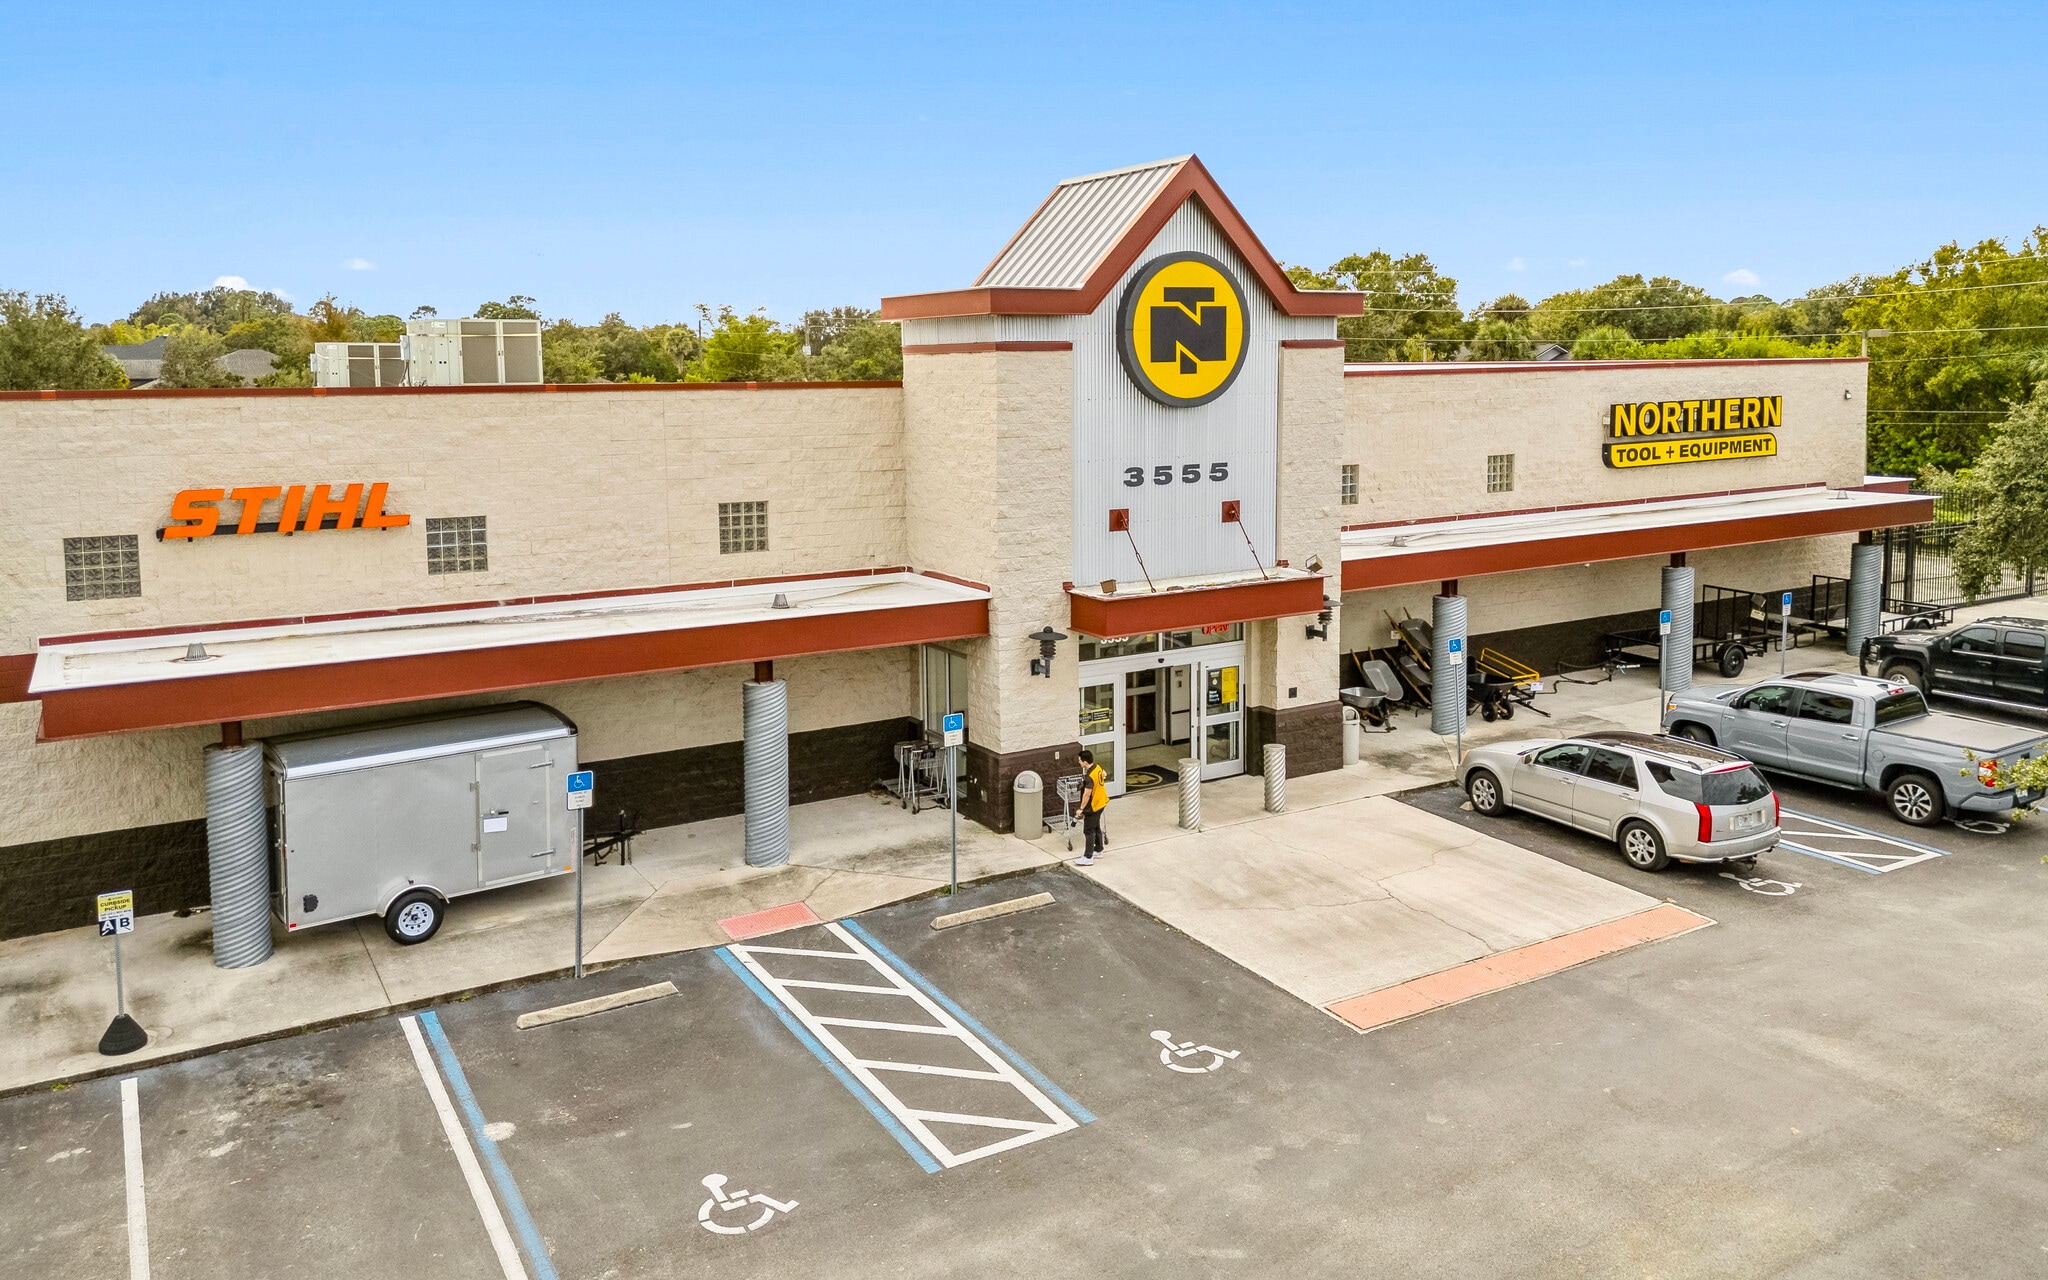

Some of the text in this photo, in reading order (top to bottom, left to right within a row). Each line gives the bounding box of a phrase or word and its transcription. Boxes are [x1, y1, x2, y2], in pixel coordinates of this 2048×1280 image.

[1610, 396, 1782, 437] NORTHERN
[1616, 447, 1661, 463] TOOL
[1679, 438, 1772, 458] EQUIPMENT
[1123, 462, 1229, 488] 3555
[163, 482, 411, 539] STIHL
[1202, 624, 1230, 635] OPEN
[100, 898, 131, 908] CURBSIDE
[104, 904, 127, 912] PICKUP
[102, 917, 131, 932] A B
